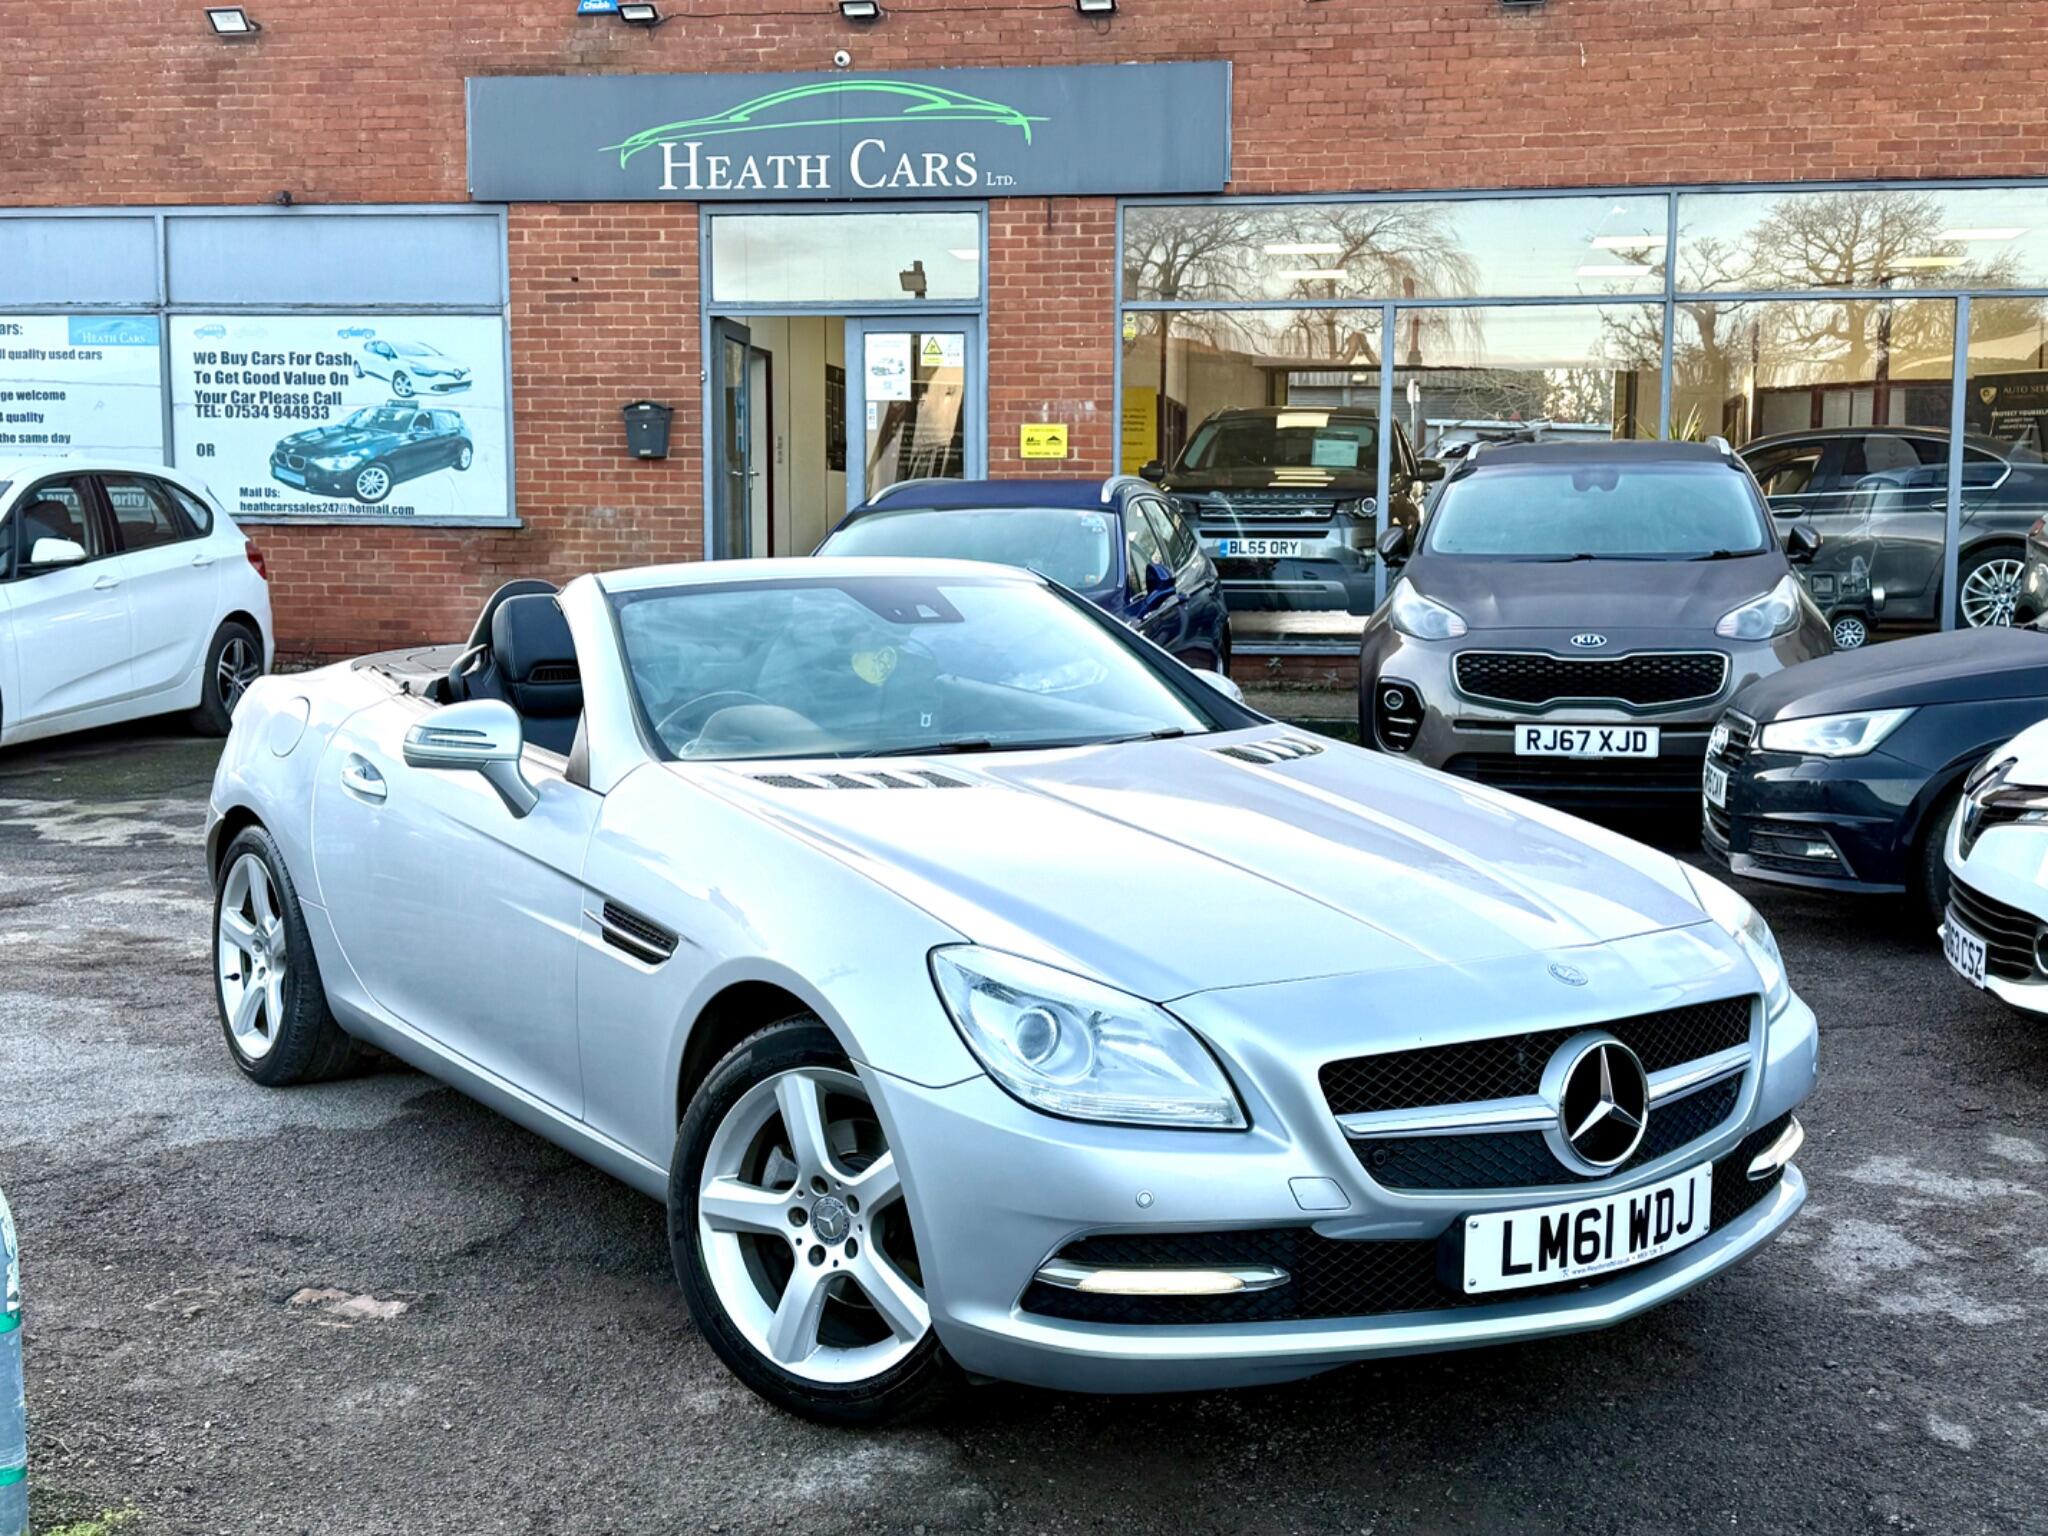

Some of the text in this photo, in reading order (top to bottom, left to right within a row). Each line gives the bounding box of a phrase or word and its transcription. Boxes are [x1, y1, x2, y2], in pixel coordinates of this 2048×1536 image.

[8, 349, 47, 361] quality
[48, 349, 76, 360] used
[78, 350, 103, 361] cars
[220, 350, 248, 367] Buy
[251, 351, 285, 366] Cars
[288, 351, 312, 366] For
[315, 351, 353, 367] Cash
[193, 370, 349, 386] To Get Good Value On
[15, 389, 67, 401] welcome
[194, 389, 342, 406] Your Car Please Call
[6, 411, 45, 424] quality
[194, 404, 330, 420] TEL: 07534 944933
[18, 433, 49, 445] same
[50, 432, 71, 445] day
[196, 443, 216, 457] OR
[239, 487, 280, 498] Mail Us:
[1269, 541, 1299, 555] ORY
[1526, 729, 1648, 753] RJ67 XJD
[1961, 936, 1984, 982] CSZ
[1501, 1203, 1615, 1277] LM61
[1628, 1177, 1696, 1254] WDJ
